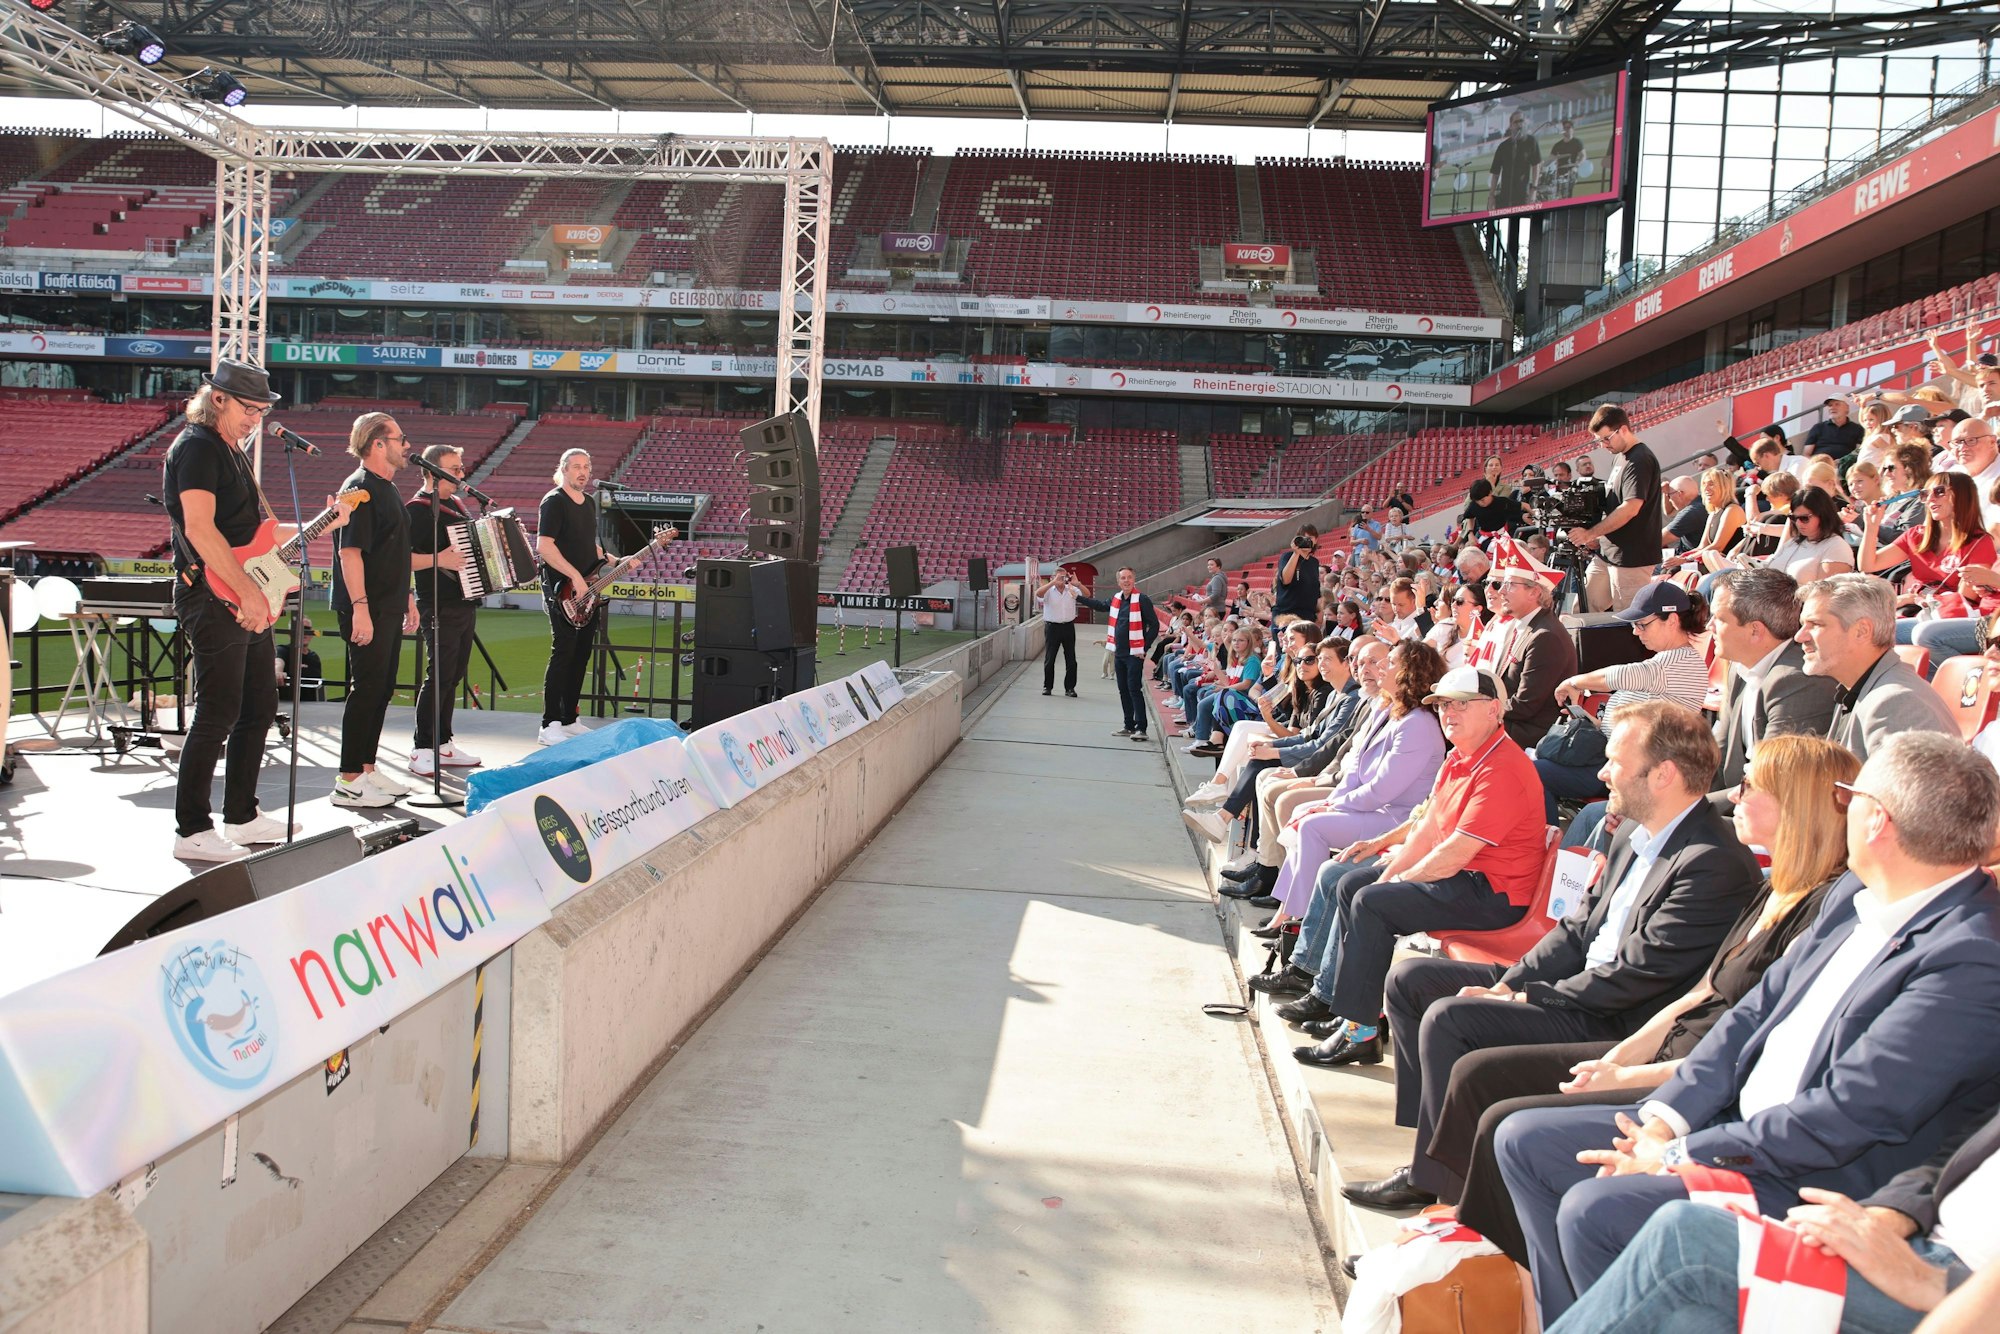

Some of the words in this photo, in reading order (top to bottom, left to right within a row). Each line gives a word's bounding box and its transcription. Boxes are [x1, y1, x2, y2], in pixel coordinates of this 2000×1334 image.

[1854, 160, 1911, 215] REWE
[566, 230, 587, 240] KVB
[895, 238, 917, 248] KVB
[1236, 249, 1259, 260] KVB
[1698, 253, 1734, 292] REWE
[45, 274, 78, 288] Gaffel
[390, 284, 425, 295] seitz
[1635, 290, 1663, 323] REWE
[1163, 311, 1211, 321] RheinEnergie
[1232, 309, 1257, 318] Rhein
[1368, 315, 1393, 324] Rhein
[1229, 316, 1262, 325] Energie
[1300, 316, 1347, 326] RheinEnergie
[1365, 322, 1398, 331] Energie
[1436, 322, 1484, 332] RheinEnergie
[49, 341, 96, 351] RheinEnergie
[1554, 336, 1574, 362] REWE
[286, 345, 341, 362] DEVK
[372, 347, 427, 360] SAUREN
[454, 353, 475, 365] HAUS
[532, 354, 556, 366] SAP
[580, 356, 605, 368] SAP
[637, 354, 686, 366] Dorint
[729, 360, 777, 375] funny-fri
[823, 363, 884, 377] OSMAB
[1518, 356, 1536, 380] REWE
[1128, 377, 1177, 387] RheinEnergie
[1193, 378, 1331, 396] RheinEnergieSTADION
[1404, 390, 1453, 399] RheinEnergie
[614, 493, 649, 502] Bäckerei
[651, 495, 693, 504] Schneider
[133, 563, 166, 573] Radio
[612, 585, 646, 598] Radio
[649, 586, 676, 598] Köln
[841, 596, 879, 608] IMMER
[747, 711, 801, 771] narwali
[581, 780, 666, 840] Kreissportbund
[658, 777, 694, 802] Düren
[539, 815, 558, 831] KREIS
[289, 844, 496, 1020] narwali
